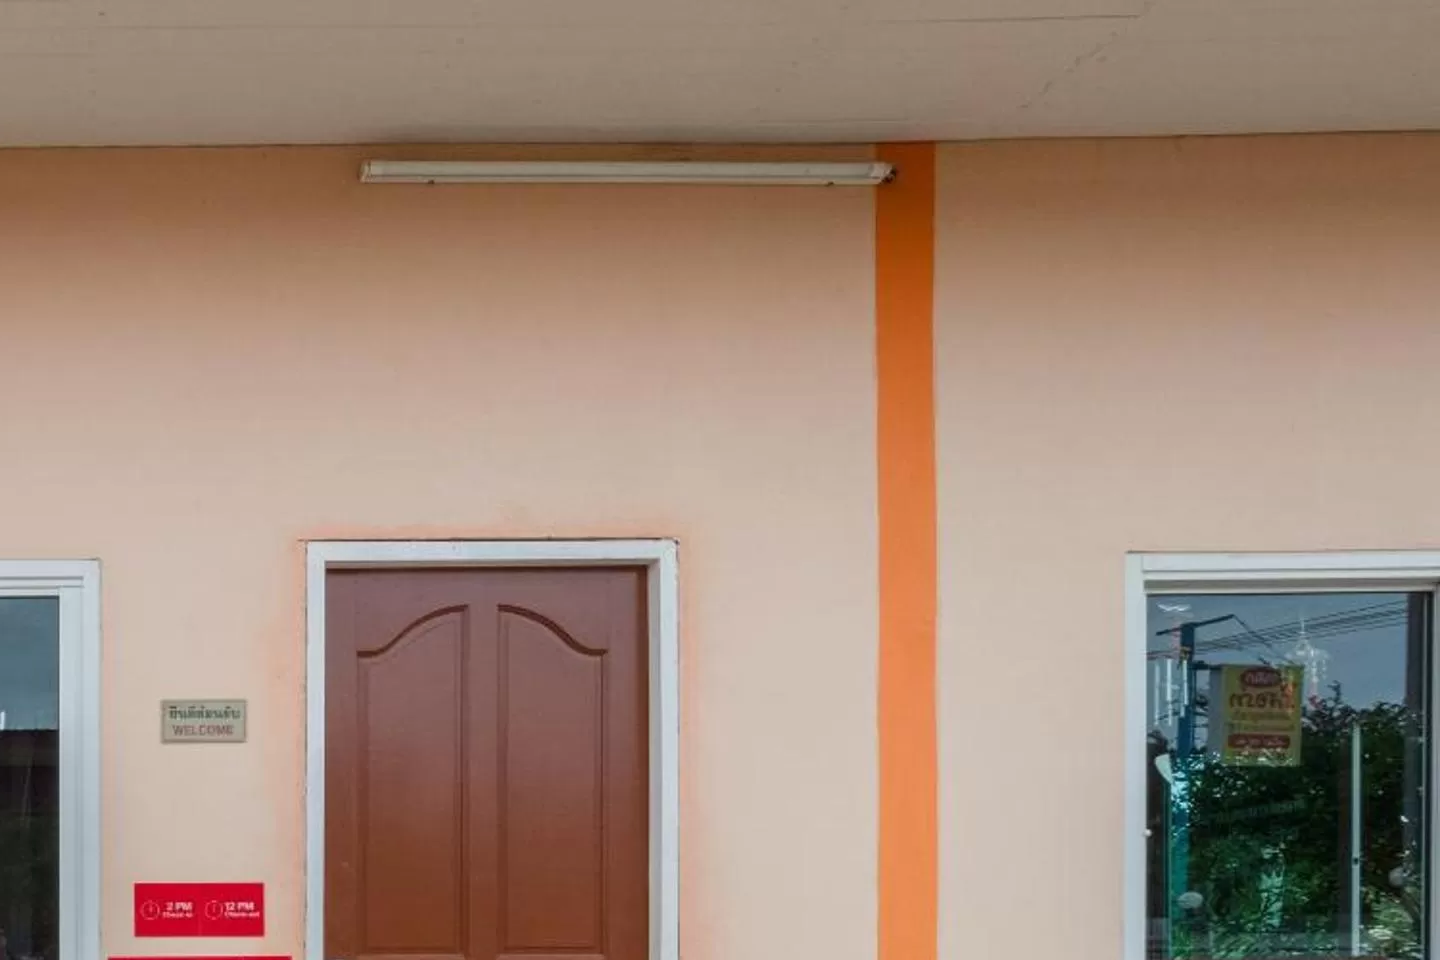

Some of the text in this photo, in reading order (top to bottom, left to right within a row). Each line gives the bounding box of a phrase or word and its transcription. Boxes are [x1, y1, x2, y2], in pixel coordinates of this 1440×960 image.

[172, 723, 234, 736] WELCOME
[175, 901, 193, 911] PM
[224, 901, 255, 911] 12 PM
